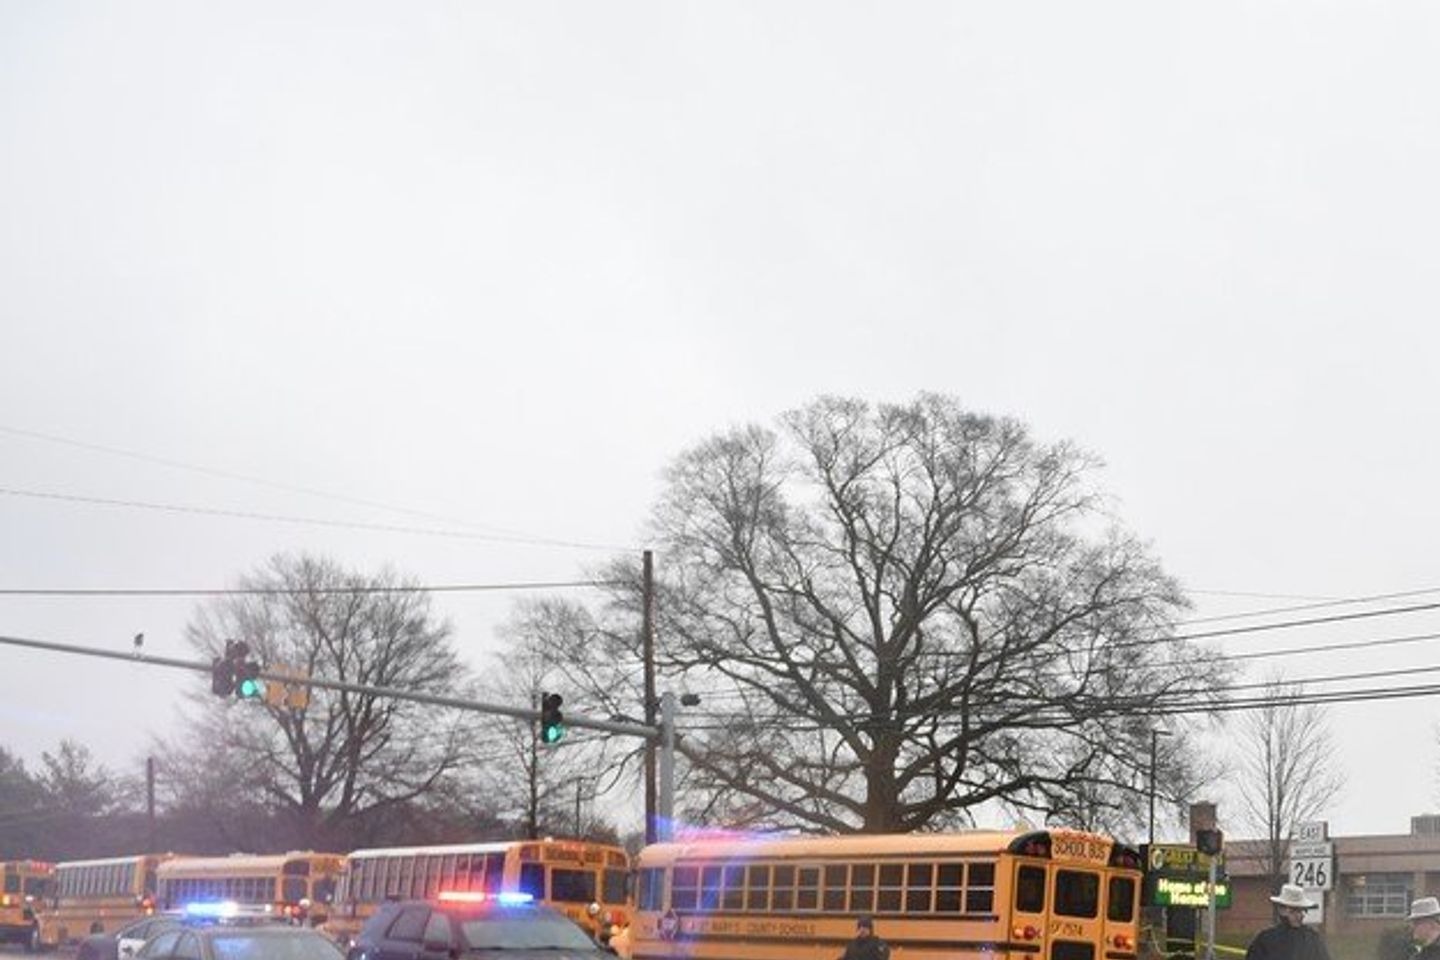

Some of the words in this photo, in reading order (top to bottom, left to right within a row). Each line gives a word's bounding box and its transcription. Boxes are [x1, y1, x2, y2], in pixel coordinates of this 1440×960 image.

[1300, 827, 1320, 840] EAST
[1054, 842, 1086, 859] SCHOOL
[1089, 846, 1106, 860] BUS
[1295, 862, 1327, 887] 246
[1158, 878, 1193, 894] Home
[1194, 881, 1208, 894] of
